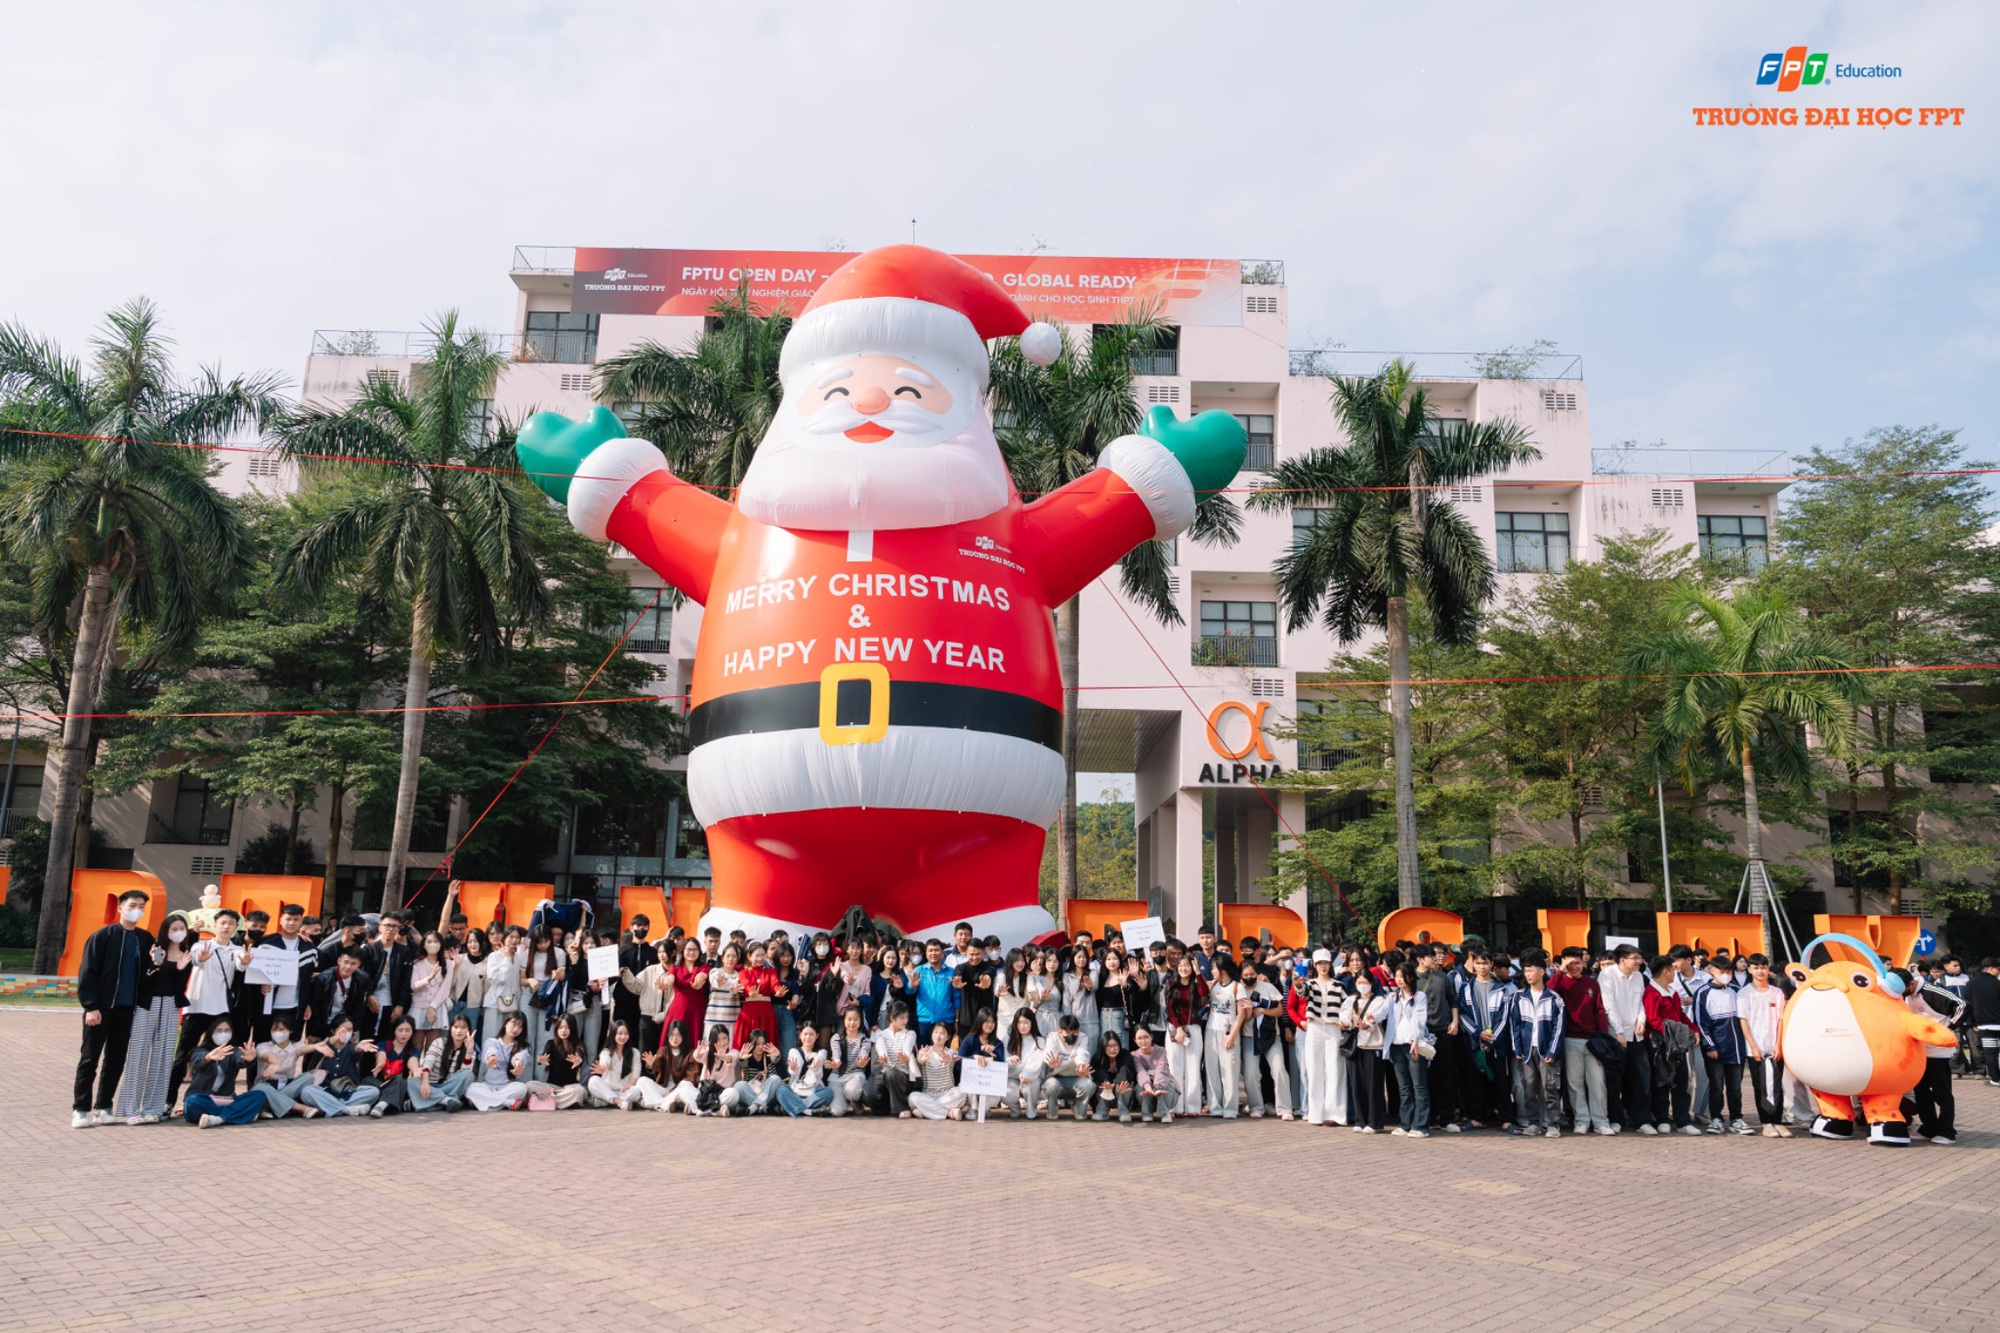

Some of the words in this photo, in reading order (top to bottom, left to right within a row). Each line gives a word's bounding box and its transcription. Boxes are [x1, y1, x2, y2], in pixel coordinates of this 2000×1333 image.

[682, 266, 724, 281] FPTU
[728, 267, 776, 282] OPEN
[781, 268, 817, 283] DAY
[1002, 273, 1074, 288] GLOBAL
[1078, 274, 1137, 290] READY
[1038, 293, 1061, 303] CHO
[1087, 294, 1110, 304] SINH
[1111, 295, 1136, 305] THPT
[725, 575, 818, 615] MERRY
[828, 573, 1010, 611] CHRISTMAS
[848, 603, 872, 628] &
[723, 638, 818, 677] HAPPY
[834, 637, 914, 662] NEW
[923, 638, 1006, 673] YEAR
[1198, 763, 1282, 784] ALPHA
